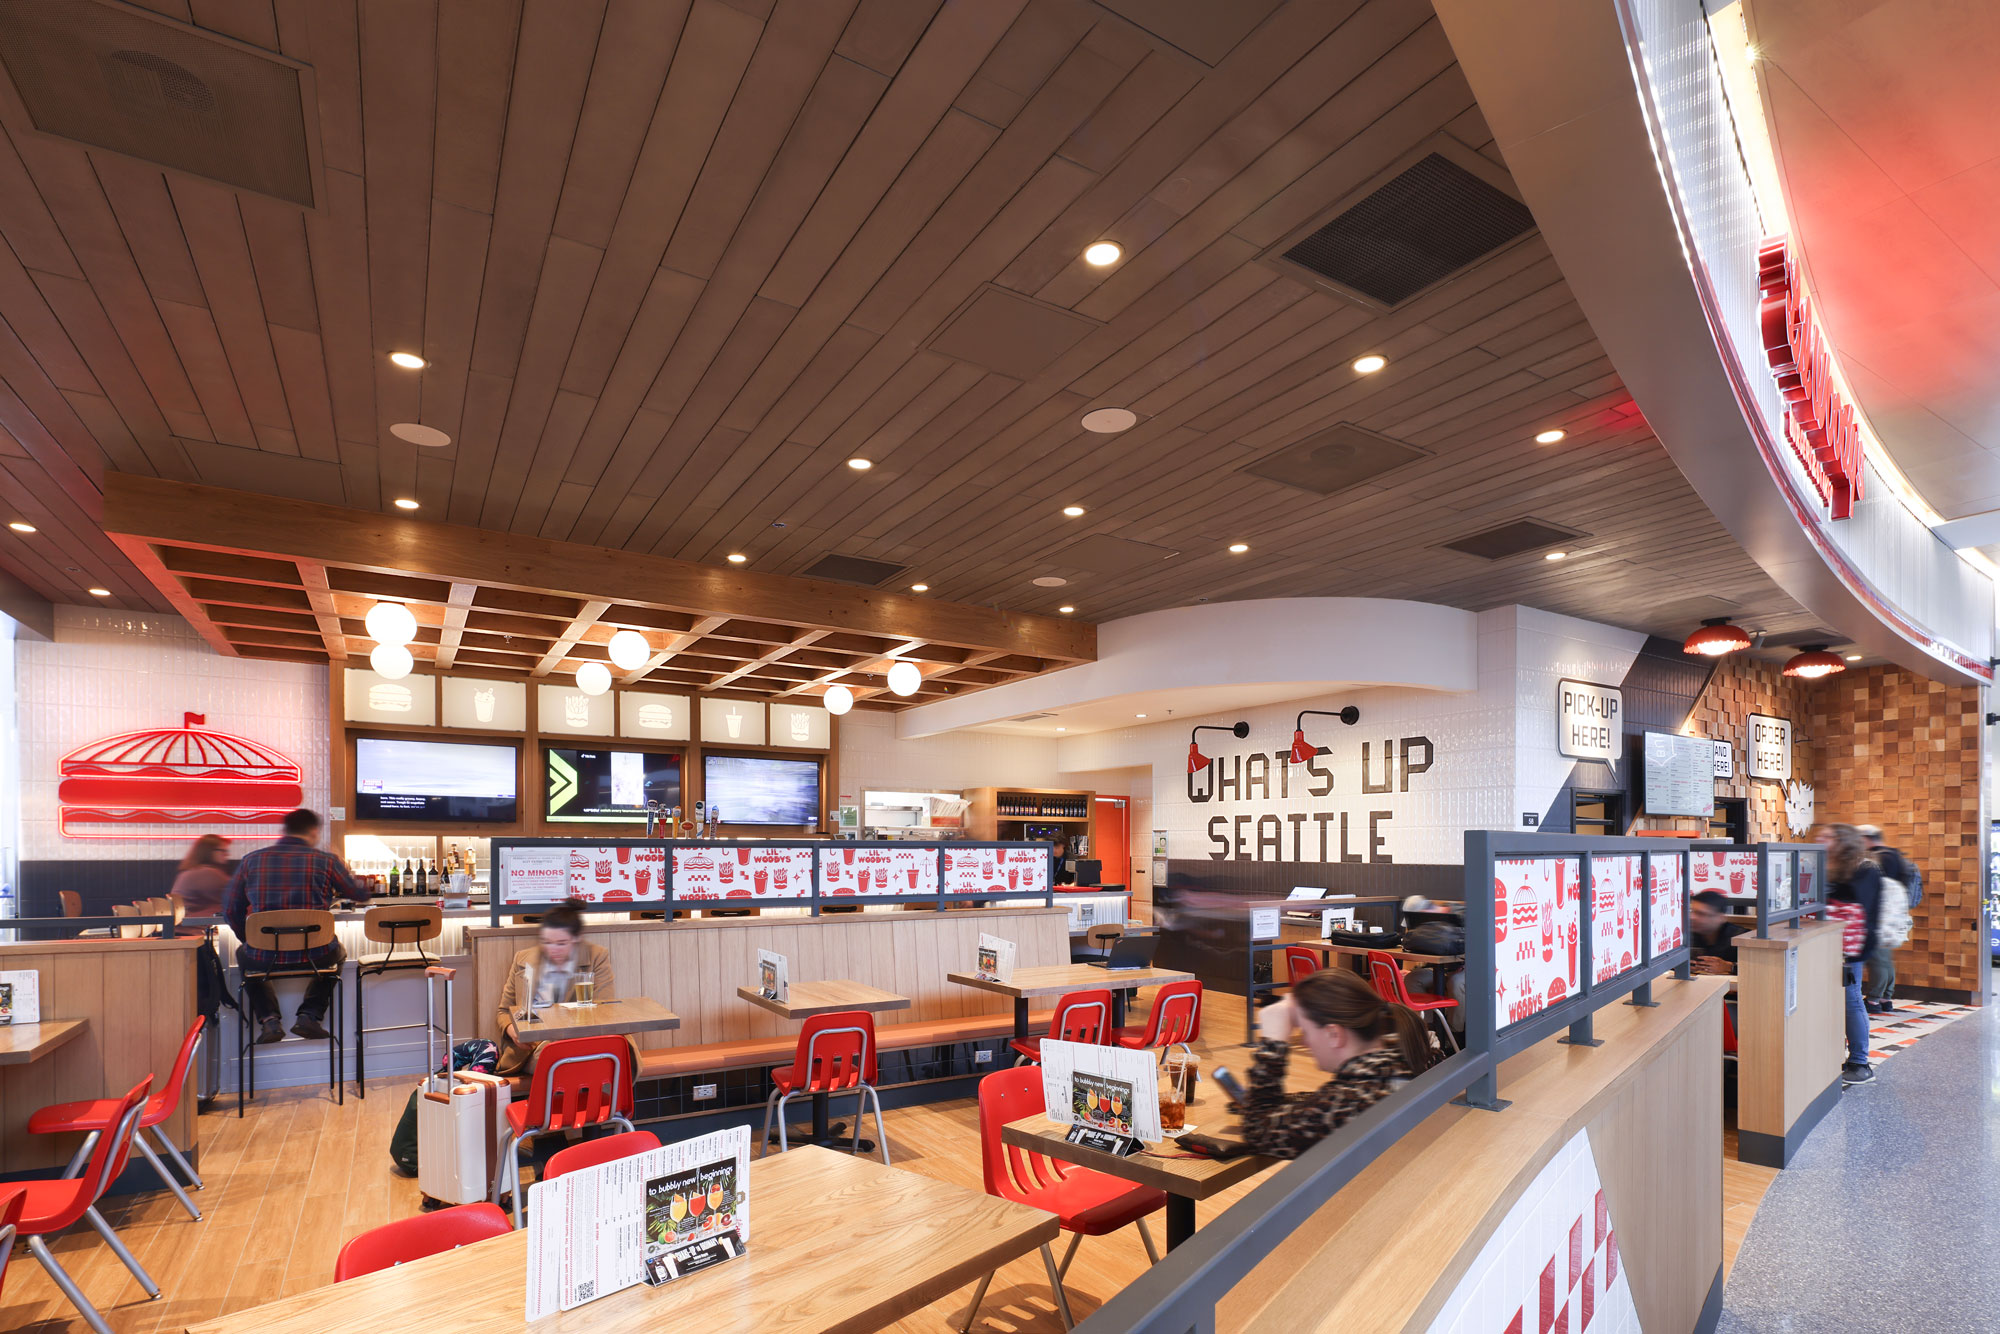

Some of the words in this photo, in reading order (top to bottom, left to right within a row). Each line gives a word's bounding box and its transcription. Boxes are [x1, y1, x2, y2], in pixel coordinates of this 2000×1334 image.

[1564, 691, 1618, 720] PICK-UP
[1572, 724, 1610, 749] HERE!
[1755, 723, 1785, 746] ORDER
[1362, 736, 1434, 795] UP
[1757, 750, 1784, 771] HERE!
[1208, 811, 1392, 864] SEATTLE
[858, 856, 891, 864] WOODYS
[511, 869, 525, 877] NO
[527, 869, 565, 877] MINORS
[1520, 973, 1532, 997] LIL
[1597, 962, 1617, 984] WOODYS
[1509, 992, 1543, 1024] WOODYS
[648, 1188, 657, 1196] to
[658, 1180, 681, 1193] bubbly
[682, 1176, 697, 1186] new
[700, 1166, 733, 1181] beginnings
